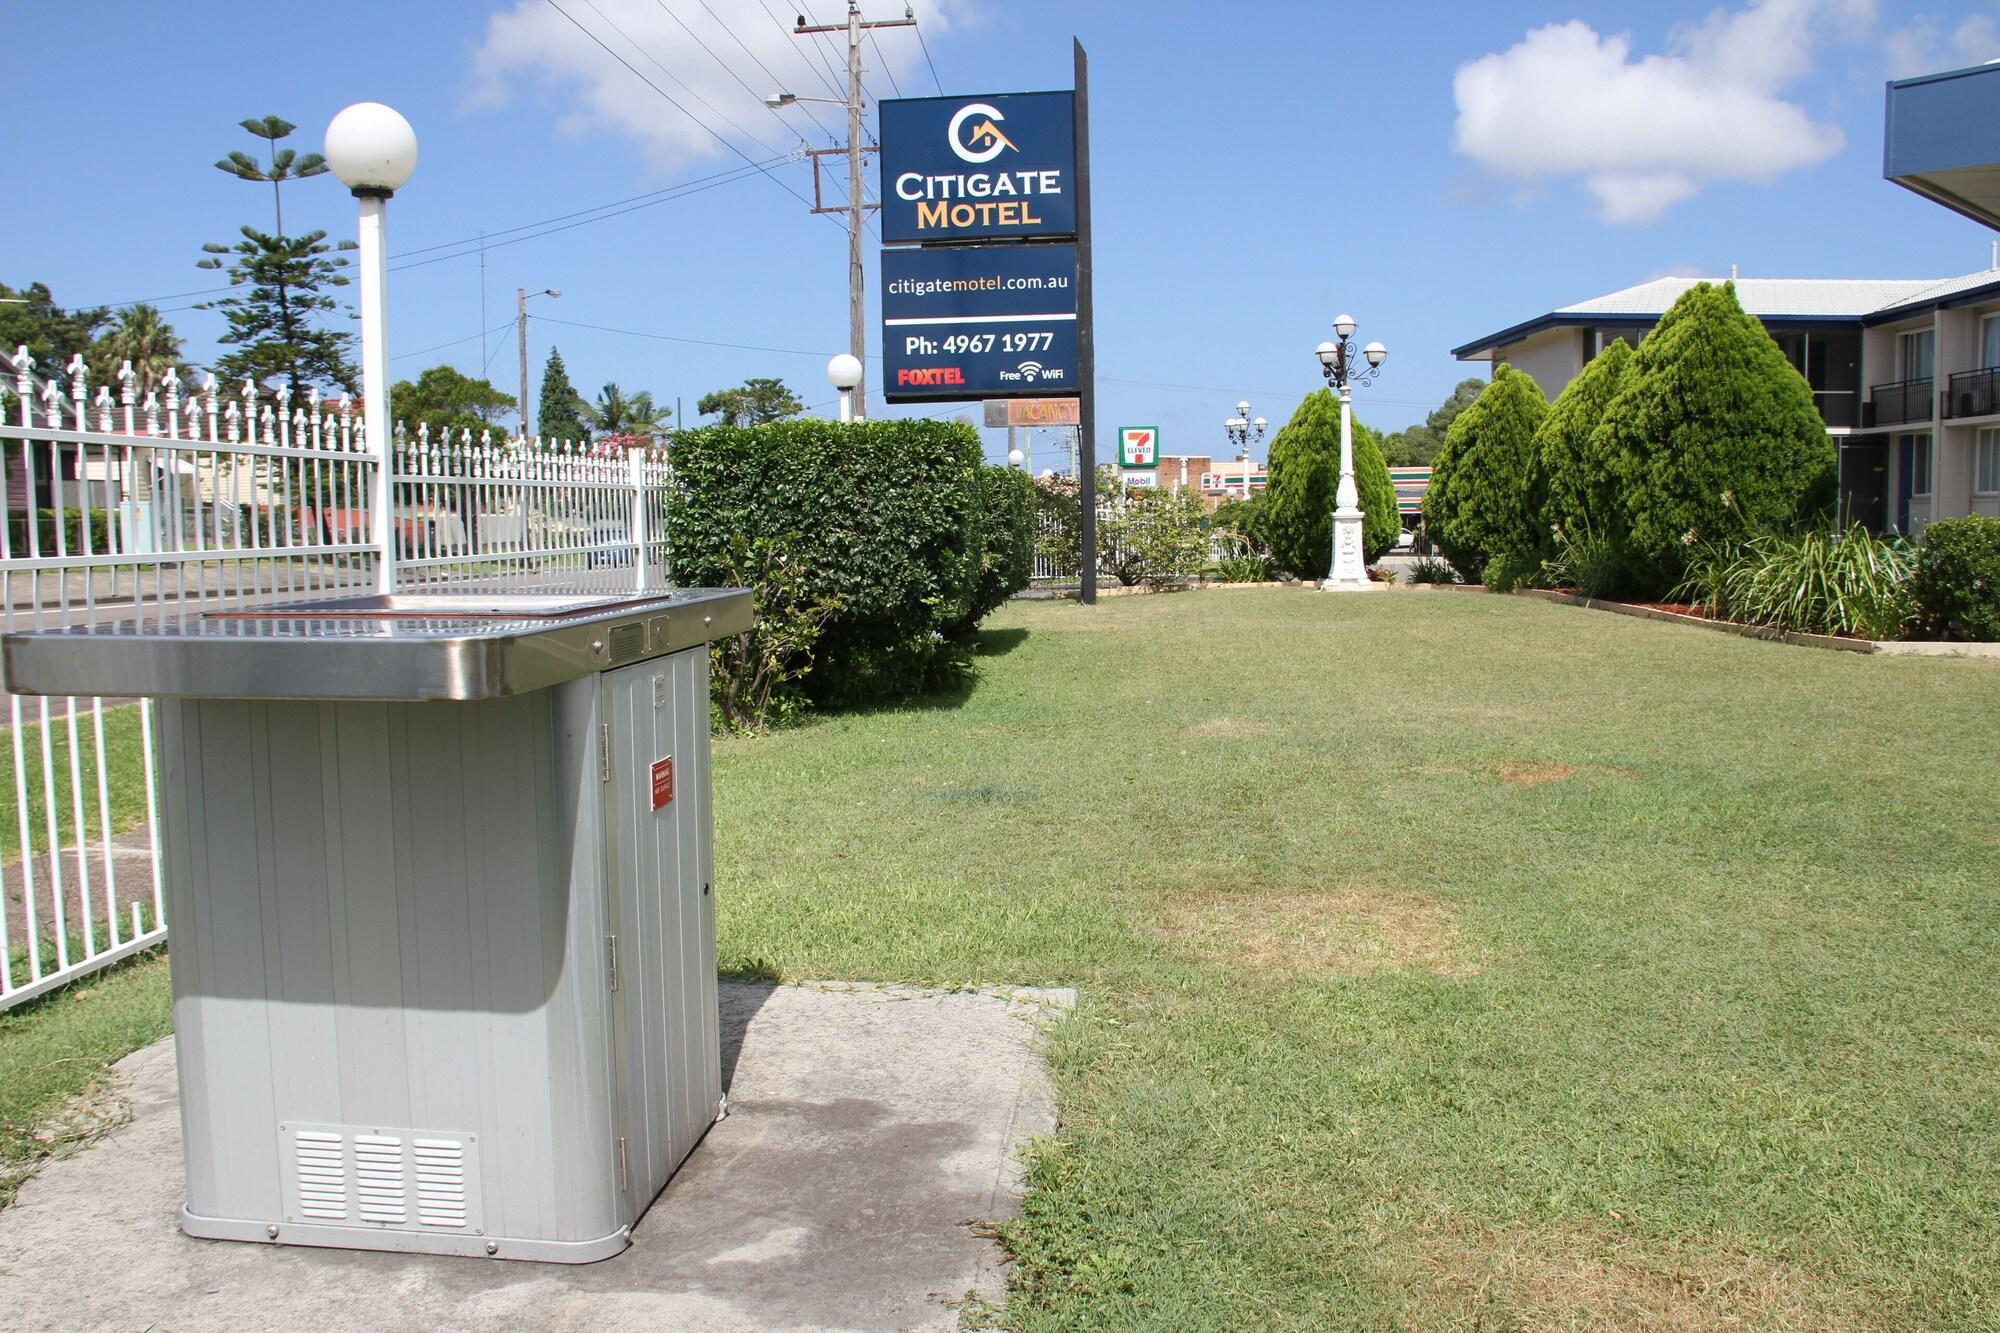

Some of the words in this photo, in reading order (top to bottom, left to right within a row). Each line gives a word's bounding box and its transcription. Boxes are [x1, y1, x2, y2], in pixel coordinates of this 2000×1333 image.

[895, 171, 1061, 201] CITIGATE
[916, 200, 1042, 229] MOTEL
[888, 275, 1068, 296] citigatemotel.com.au
[905, 336, 938, 355] Ph:
[942, 334, 996, 354] 4967
[1001, 332, 1054, 352] 1977
[897, 367, 966, 386] FOXTEL
[1000, 370, 1021, 380] Free
[1041, 368, 1064, 380] WiFi
[1015, 403, 1077, 420] VACANCY
[1127, 432, 1150, 464] 7
[1128, 477, 1151, 485] Mobil
